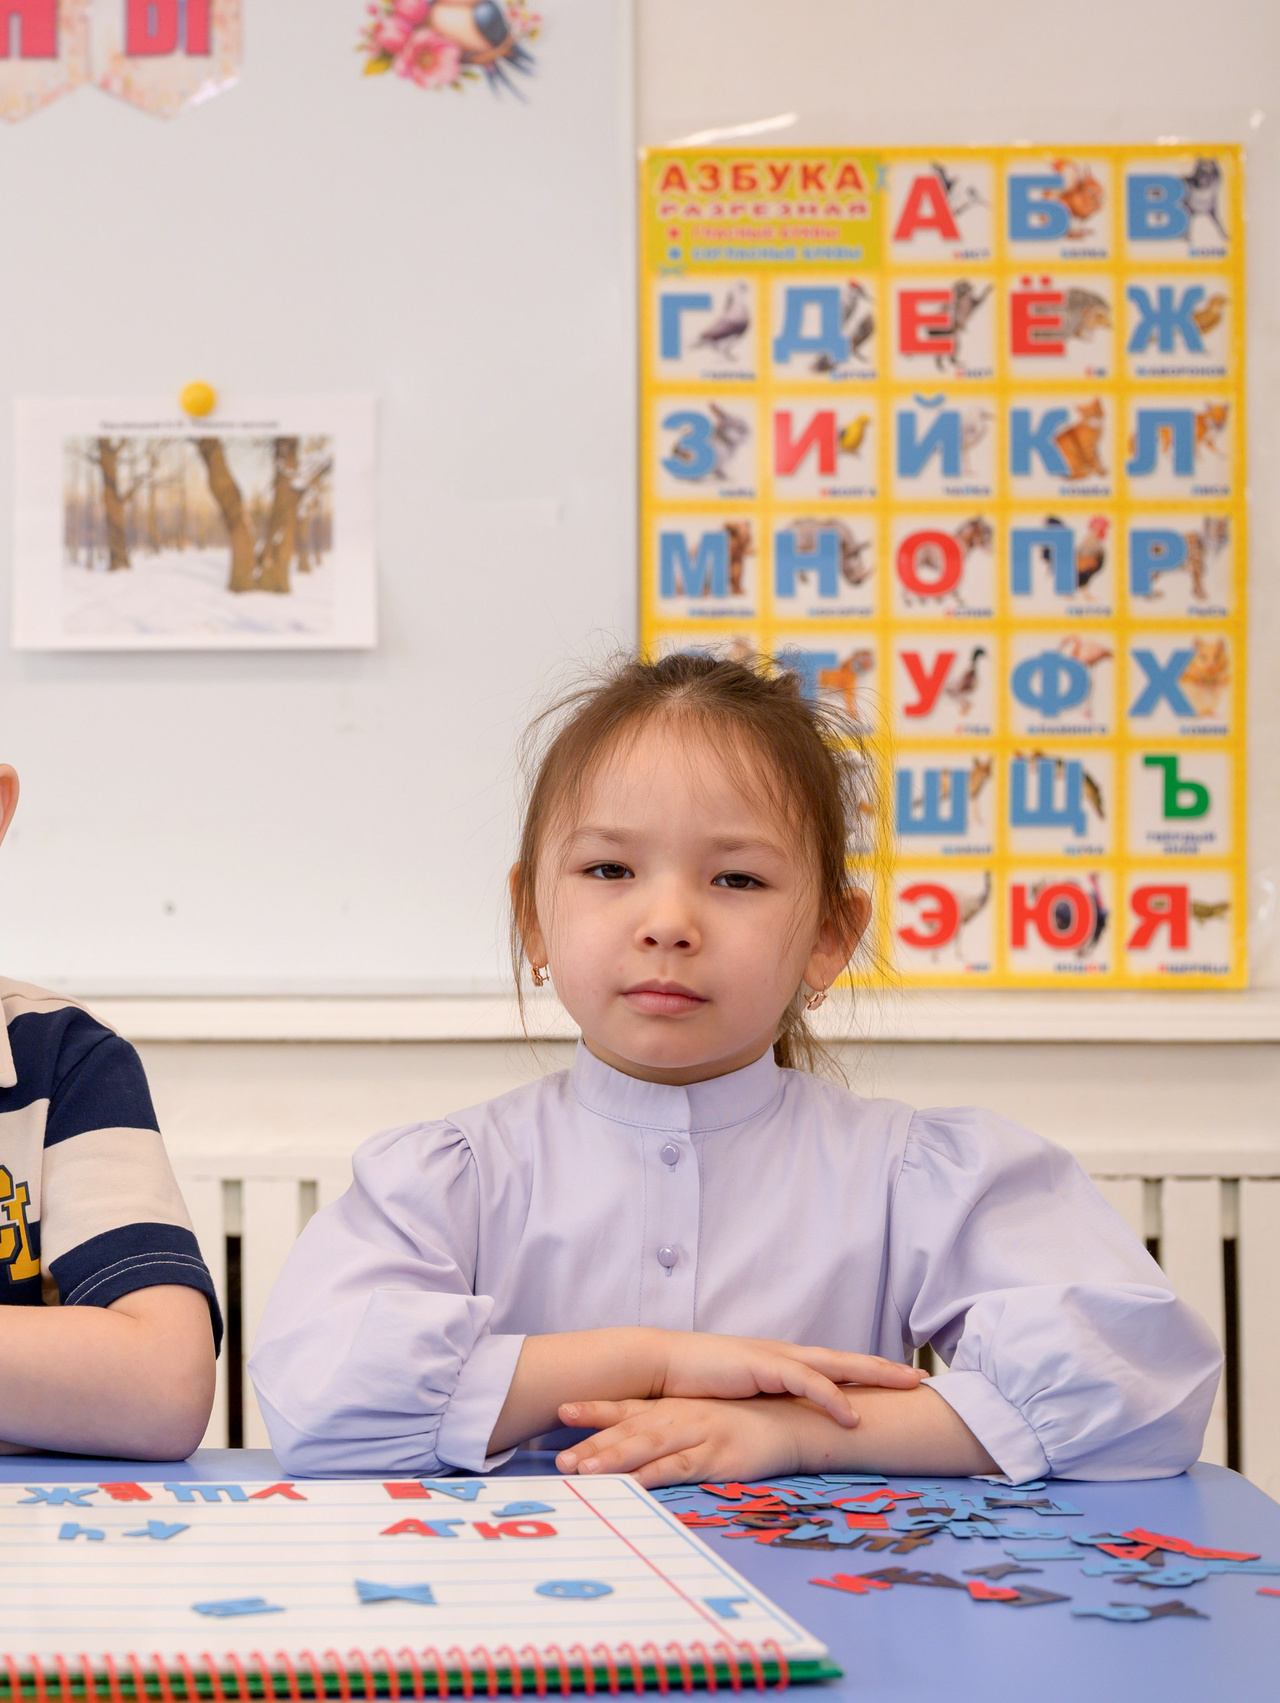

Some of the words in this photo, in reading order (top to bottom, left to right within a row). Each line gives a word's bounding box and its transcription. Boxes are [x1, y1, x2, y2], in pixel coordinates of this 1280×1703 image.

[659, 163, 866, 193] АЗБУКА
[893, 176, 961, 241] А
[1008, 175, 1070, 240] Б
[1127, 175, 1189, 240] В
[659, 294, 712, 360] Г
[773, 287, 849, 364] Д
[897, 289, 956, 355] Е
[1009, 276, 1067, 357] Ё
[1126, 286, 1206, 353] Ж
[661, 410, 716, 481] З
[773, 410, 837, 476] И
[896, 393, 963, 478] Й
[1009, 408, 1070, 476] К
[1125, 409, 1196, 478] Л
[660, 532, 729, 598] М
[775, 531, 839, 597] Н
[895, 529, 965, 597] О
[1010, 528, 1076, 596] П
[1129, 529, 1187, 598] Р
[899, 651, 956, 718] У
[1010, 651, 1090, 717] Ф
[1128, 649, 1197, 717] Х
[896, 769, 969, 835] Ш
[1009, 759, 1087, 836] Щ
[1142, 755, 1211, 820] Ъ
[896, 882, 963, 950] Э
[1008, 882, 1096, 951] Ю
[1126, 884, 1191, 950] Я
